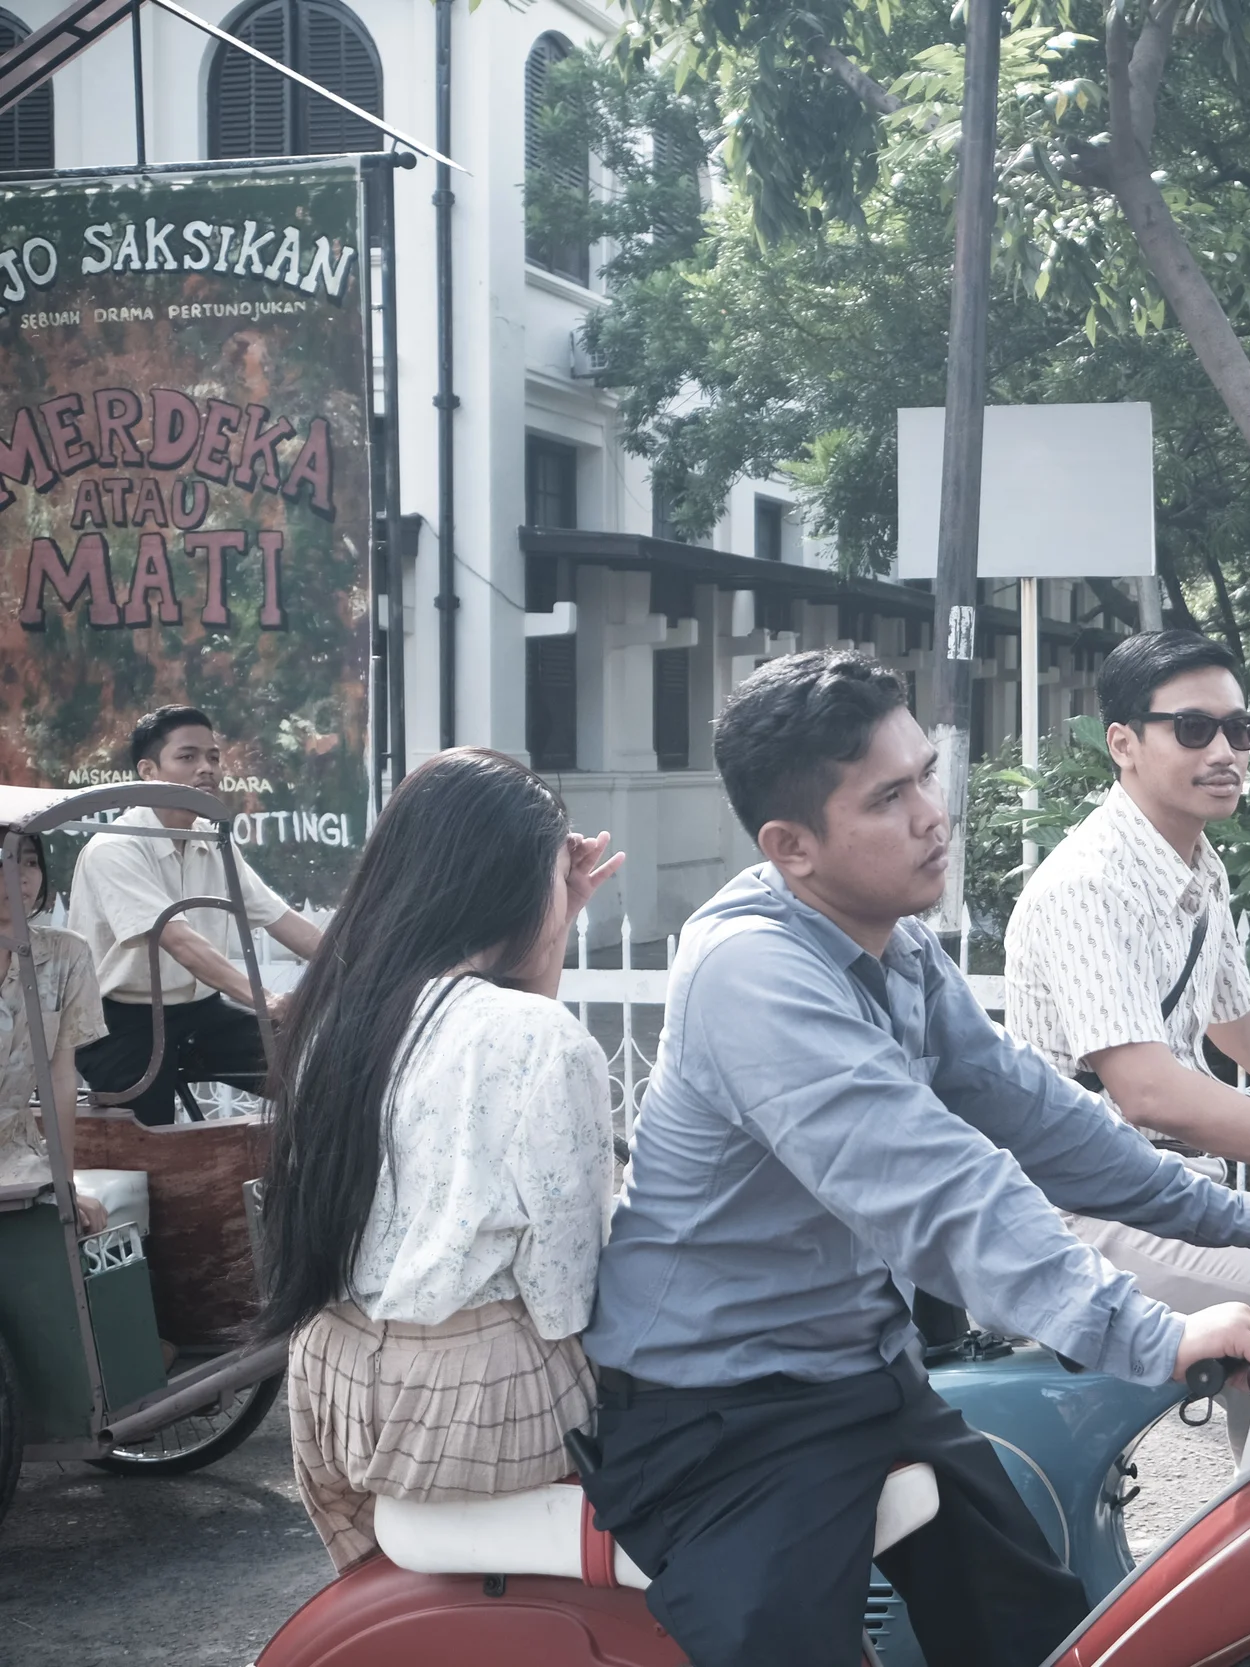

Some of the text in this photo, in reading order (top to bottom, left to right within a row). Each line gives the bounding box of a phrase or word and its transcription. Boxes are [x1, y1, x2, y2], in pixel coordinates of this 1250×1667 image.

[0, 217, 354, 303] JO SAKSIKAN
[20, 300, 307, 330] SEBUAH DRAMA PERTUNDJUKAN
[0, 388, 335, 522] MERDEKA
[71, 477, 210, 530] ATAU
[20, 529, 288, 632] MATI
[67, 769, 274, 794] NASKAH DARA
[233, 810, 350, 848] OTTINGI
